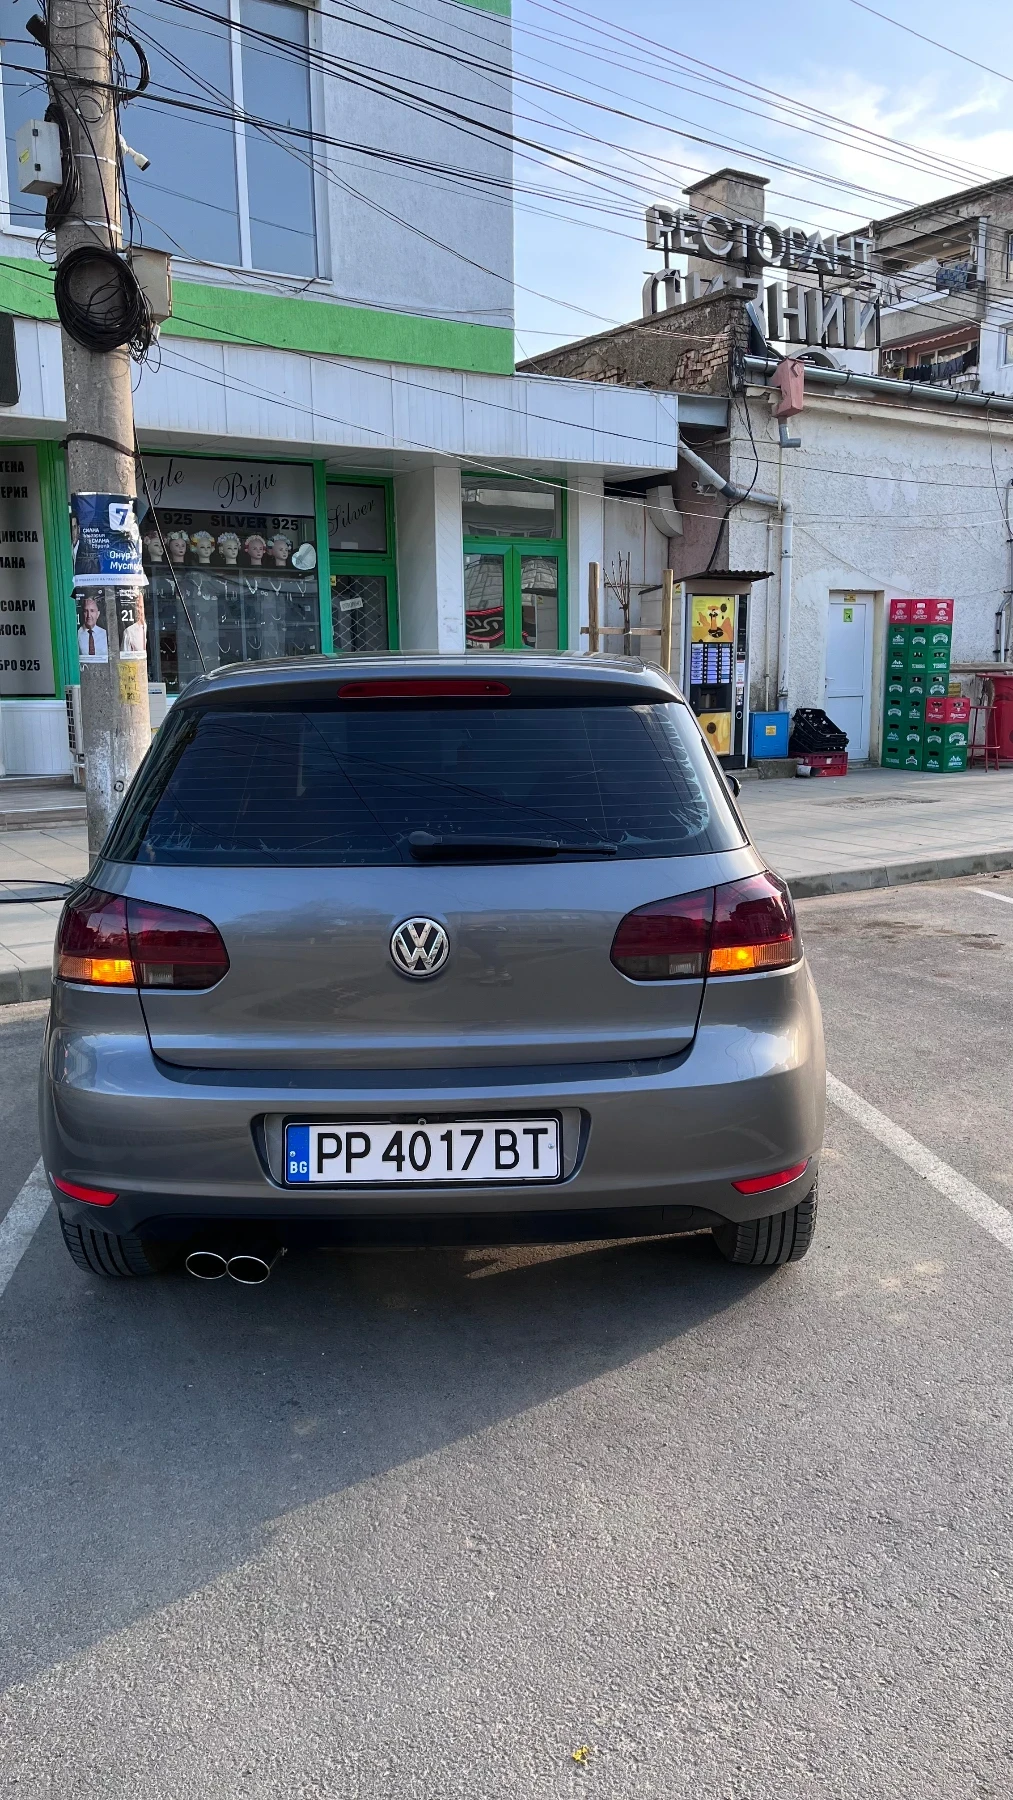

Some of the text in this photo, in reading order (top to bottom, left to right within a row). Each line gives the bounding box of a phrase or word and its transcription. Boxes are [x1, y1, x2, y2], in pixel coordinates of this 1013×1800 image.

[645, 204, 874, 276] РЕСТОРАНТ
[1, 486, 29, 499] ЕРИЯ
[212, 471, 277, 509] Biju
[115, 508, 129, 526] 7
[163, 513, 193, 526] 925
[210, 515, 300, 532] SILVER 925
[327, 498, 377, 537] Silver
[109, 550, 131, 561] Онур
[121, 609, 135, 622] 21
[19, 659, 41, 672] 925
[392, 918, 448, 975] VW
[316, 1127, 549, 1174] PP 4017 BT
[289, 1161, 308, 1174] BG
